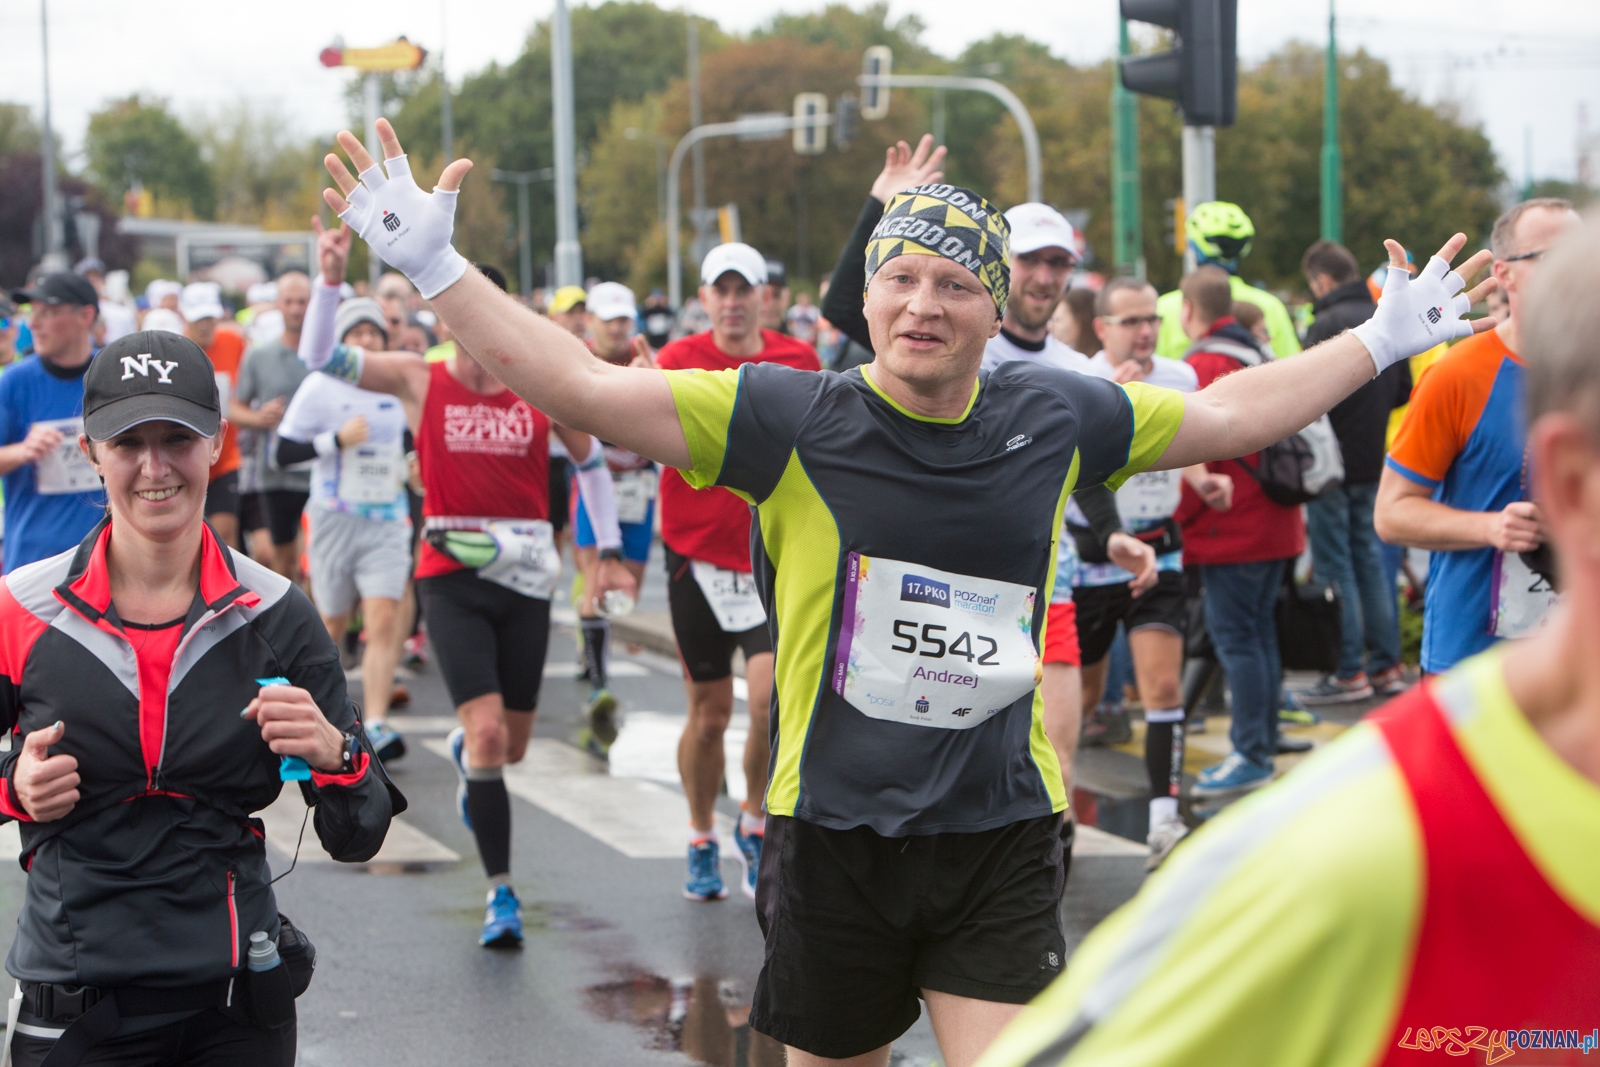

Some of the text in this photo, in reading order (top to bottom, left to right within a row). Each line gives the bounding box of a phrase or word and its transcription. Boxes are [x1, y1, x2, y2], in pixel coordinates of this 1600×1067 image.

[120, 353, 179, 384] NY
[444, 418, 534, 444] SZPIKU
[954, 600, 995, 614] maraton
[891, 618, 1000, 666] 5542
[913, 666, 979, 689] Andrzej
[951, 708, 972, 717] 4F
